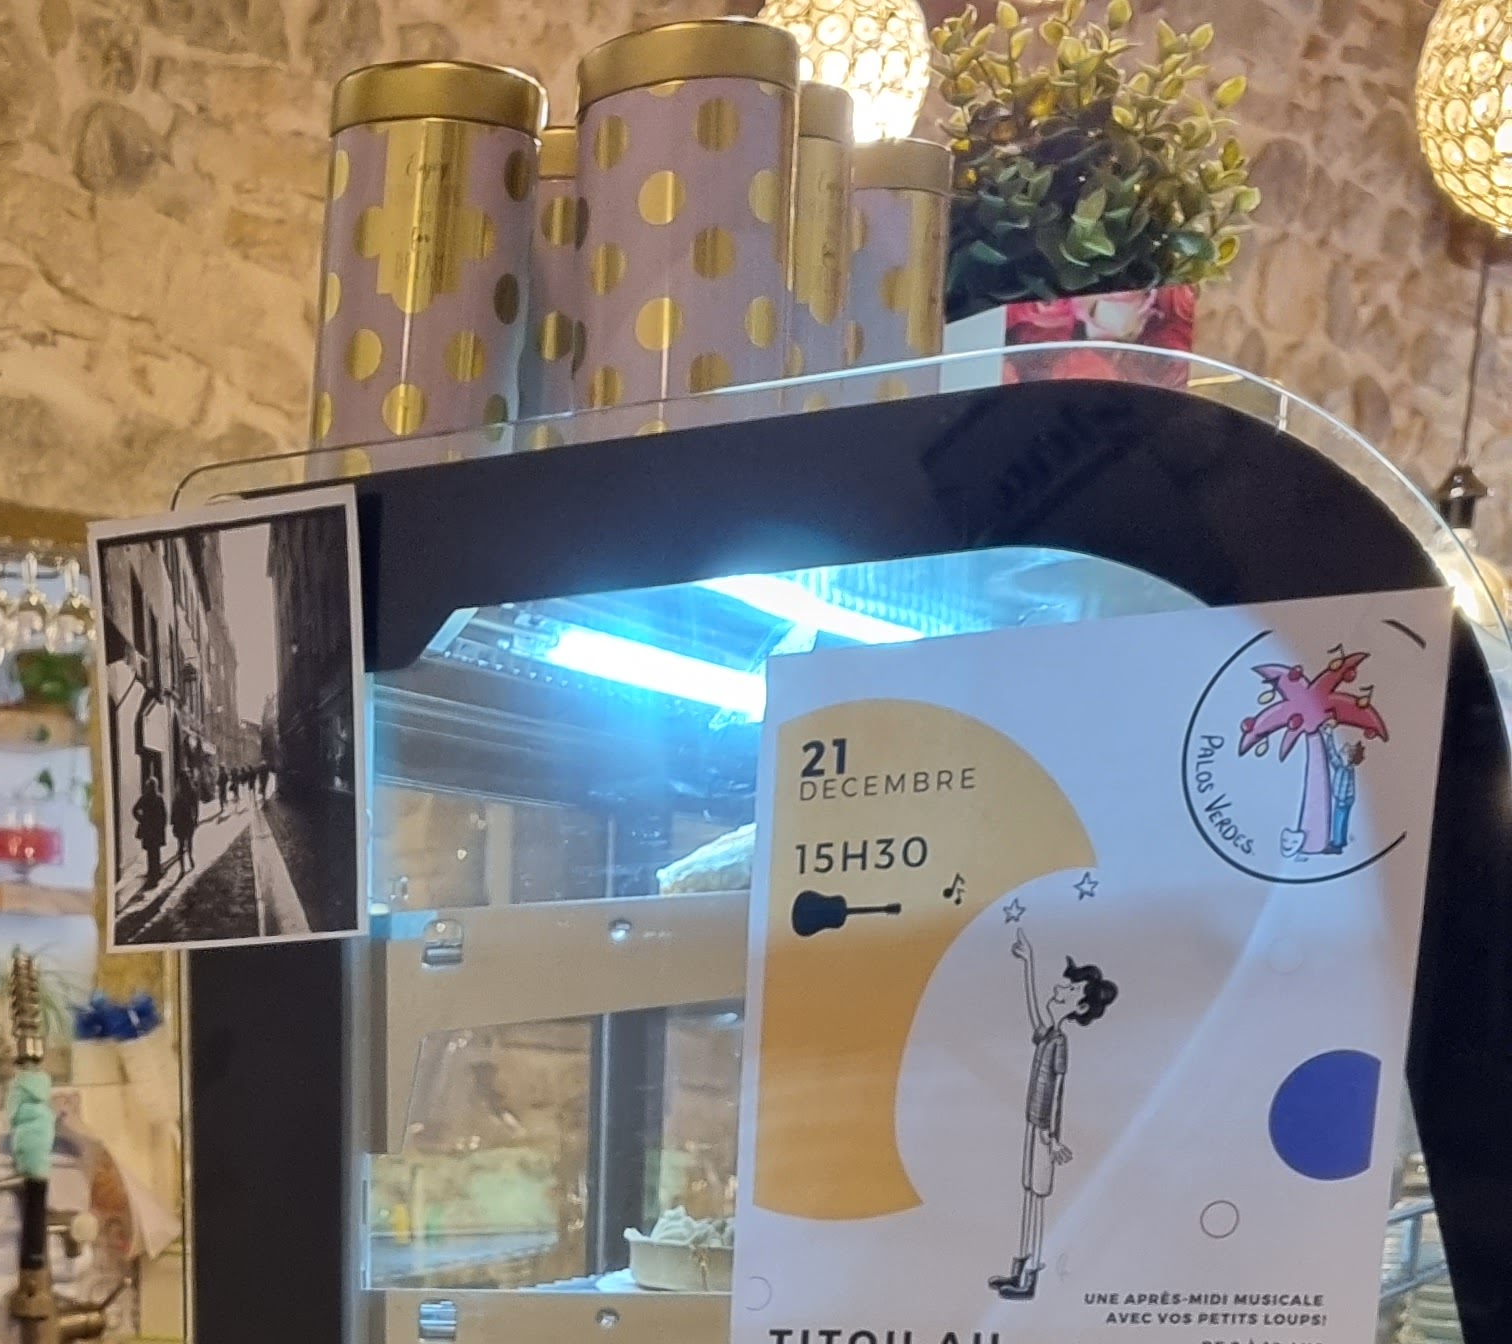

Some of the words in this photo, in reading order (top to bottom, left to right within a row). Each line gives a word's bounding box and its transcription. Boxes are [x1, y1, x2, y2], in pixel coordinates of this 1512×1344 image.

[801, 737, 848, 778] 21
[1194, 734, 1225, 794] PALOS
[798, 767, 978, 801] DECEMBRE
[794, 835, 929, 875] 15H30
[1084, 1293, 1120, 1305] UNE
[1124, 1291, 1229, 1305] APRÈS-MIDI
[1233, 1294, 1324, 1307] MUSICALE
[1105, 1312, 1153, 1325] AVEC
[1157, 1312, 1192, 1325] VOS
[1197, 1313, 1258, 1326] PETITS
[1263, 1314, 1327, 1327] LOUPS!
